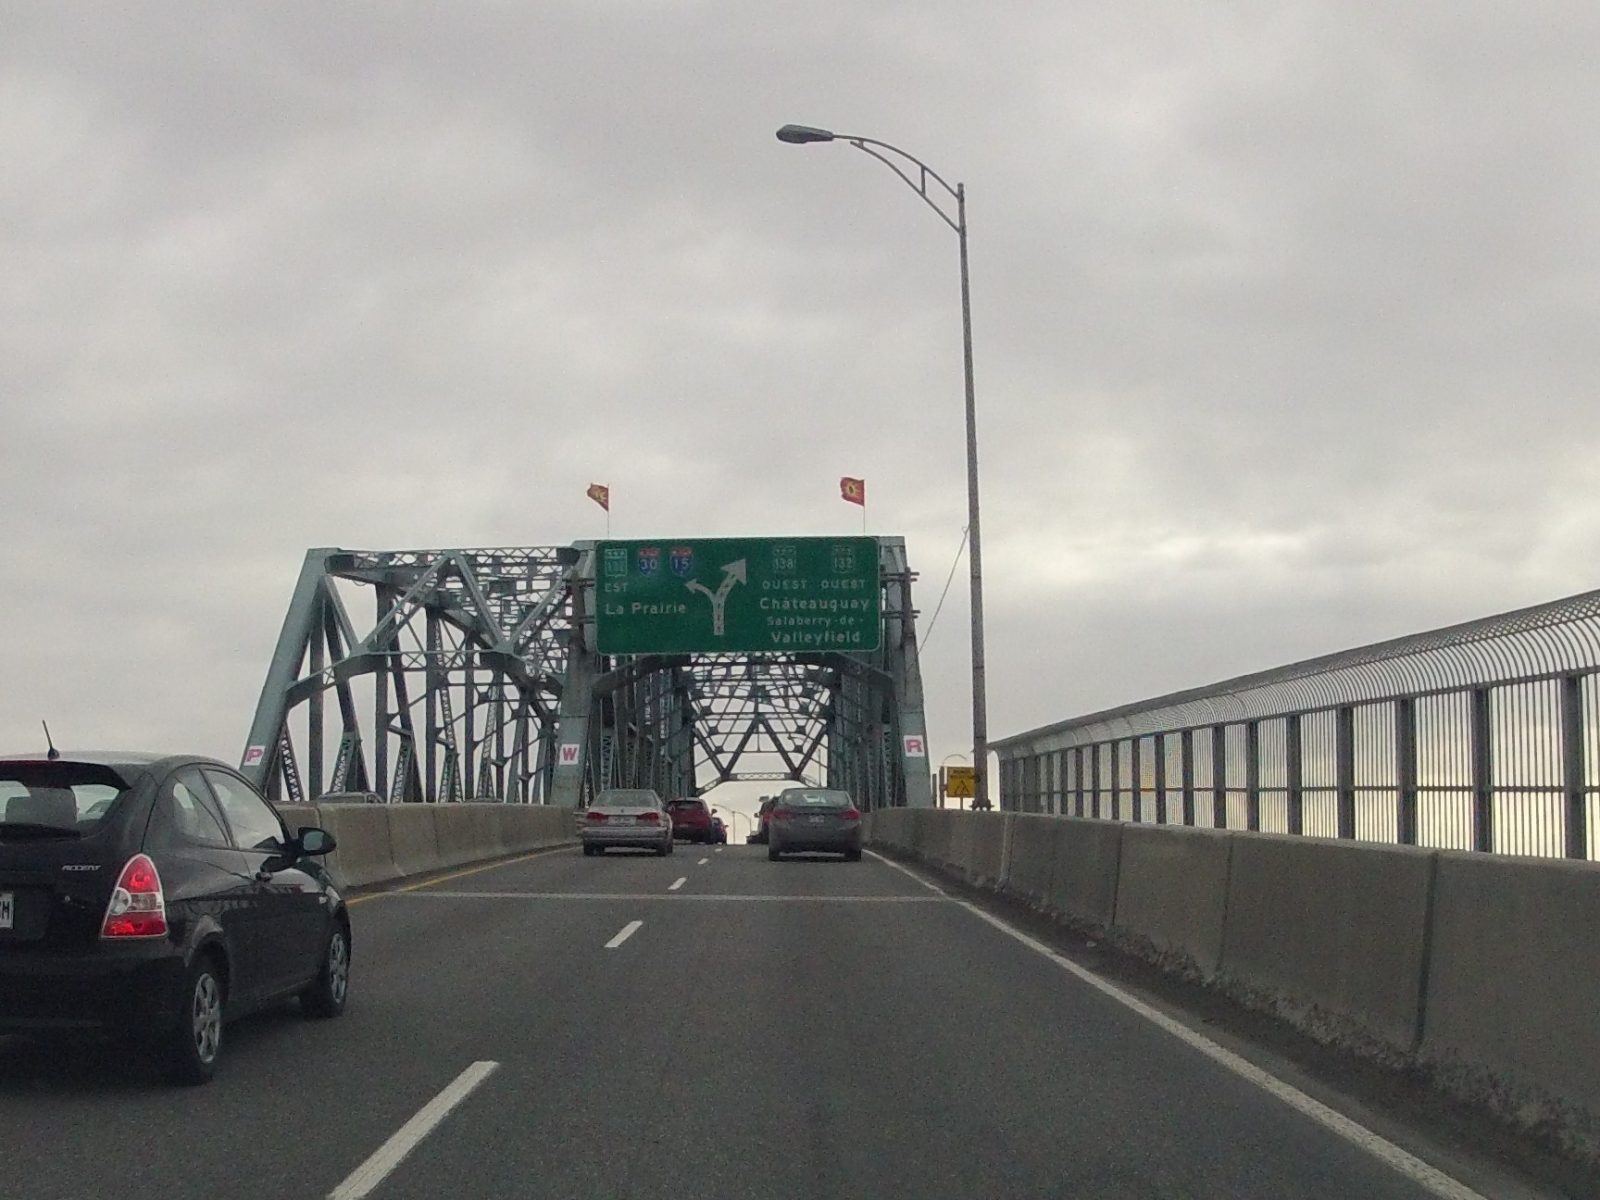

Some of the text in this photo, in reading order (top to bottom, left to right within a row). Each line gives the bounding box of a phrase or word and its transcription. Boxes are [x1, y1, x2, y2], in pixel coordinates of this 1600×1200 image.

[640, 559, 658, 570] 30
[673, 558, 689, 570] 15
[604, 582, 628, 593] EST
[762, 579, 866, 590] OUEST OUEST
[605, 602, 687, 615] La Prairie
[771, 631, 861, 645] Valleyfield
[906, 739, 923, 753] R
[245, 749, 263, 762] P
[562, 747, 578, 761] W
